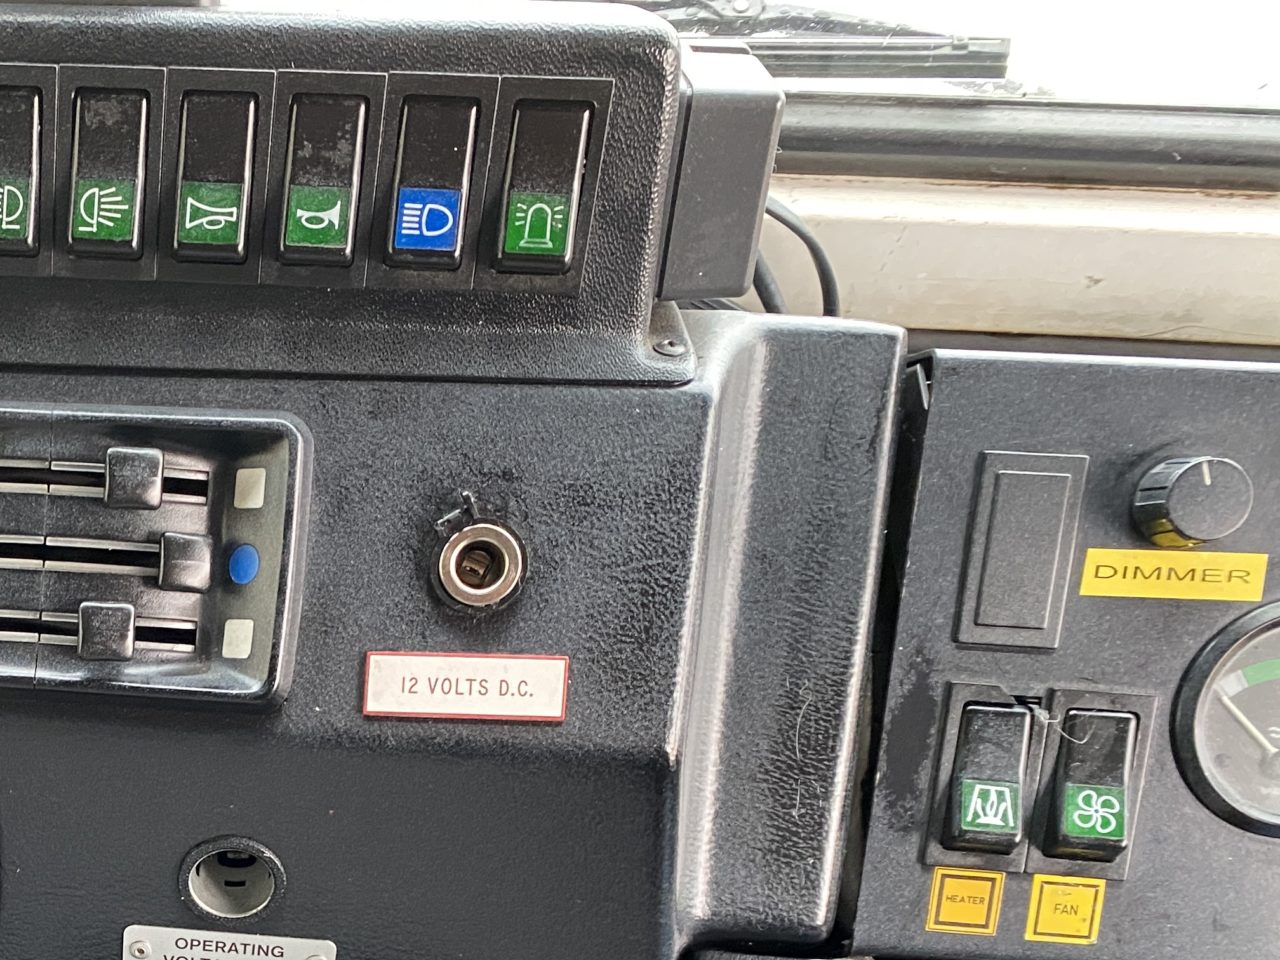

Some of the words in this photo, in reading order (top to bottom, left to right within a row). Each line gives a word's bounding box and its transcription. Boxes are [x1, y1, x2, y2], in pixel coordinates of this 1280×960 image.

[1093, 564, 1251, 584] DIMMER
[401, 676, 418, 694] 12
[428, 676, 489, 697] VOLTS
[499, 679, 534, 698] D.C.
[945, 894, 986, 906] HEATER
[1053, 903, 1079, 916] FAN
[174, 937, 285, 958] OPERATING
